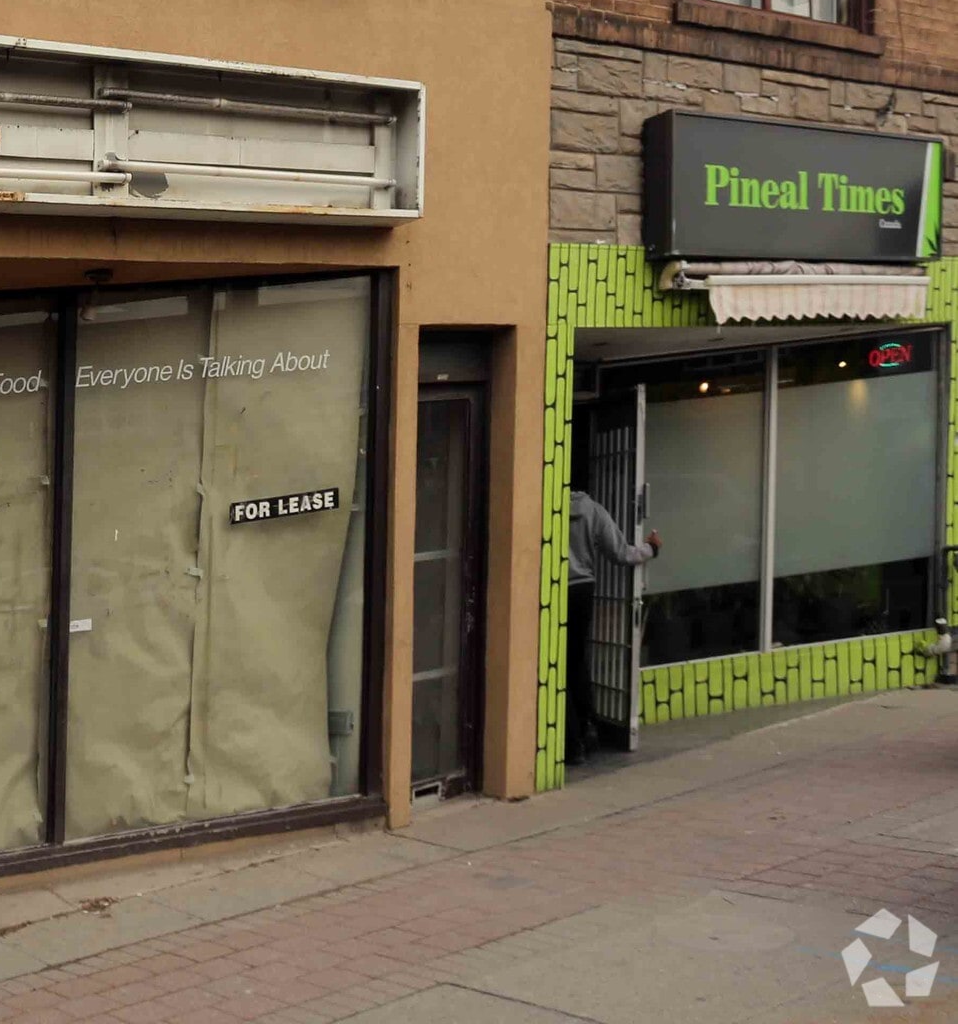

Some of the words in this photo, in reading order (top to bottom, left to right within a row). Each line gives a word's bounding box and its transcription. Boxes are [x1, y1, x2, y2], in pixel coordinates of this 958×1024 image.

[704, 164, 809, 210] Pineal
[817, 173, 906, 215] Times
[75, 364, 173, 389] Everyone
[176, 359, 194, 380] Is
[199, 355, 265, 379] Talking
[270, 349, 331, 373] About
[869, 345, 912, 367] OPEN
[235, 501, 271, 522] FOR
[278, 491, 335, 515] LEASE
